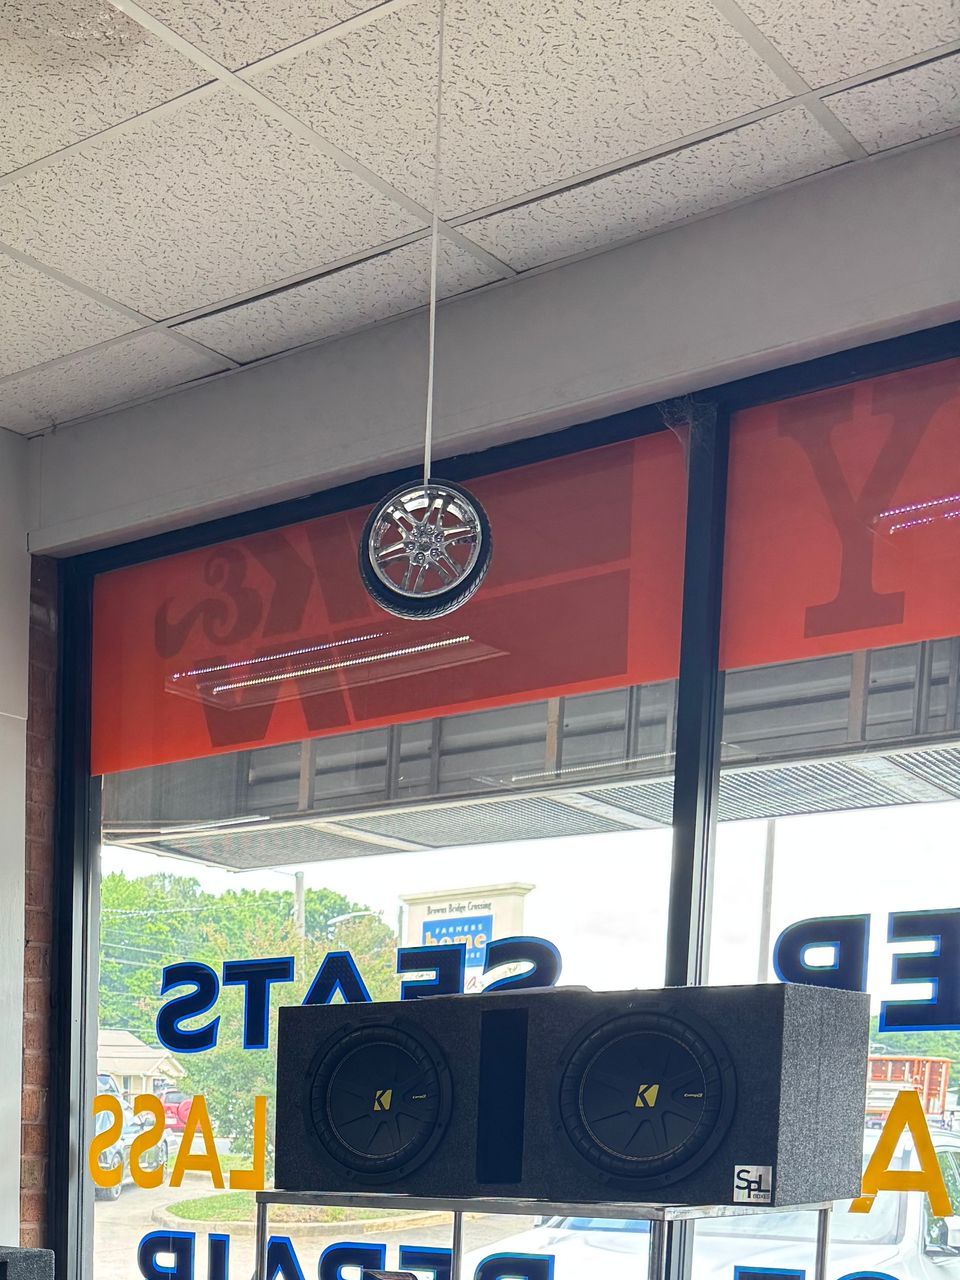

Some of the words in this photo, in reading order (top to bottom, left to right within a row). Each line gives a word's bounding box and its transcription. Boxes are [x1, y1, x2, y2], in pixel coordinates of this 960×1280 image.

[427, 905, 447, 915] Browns
[448, 903, 466, 914] Bridge
[467, 902, 492, 911] Crossing
[435, 923, 483, 935] FARMERS
